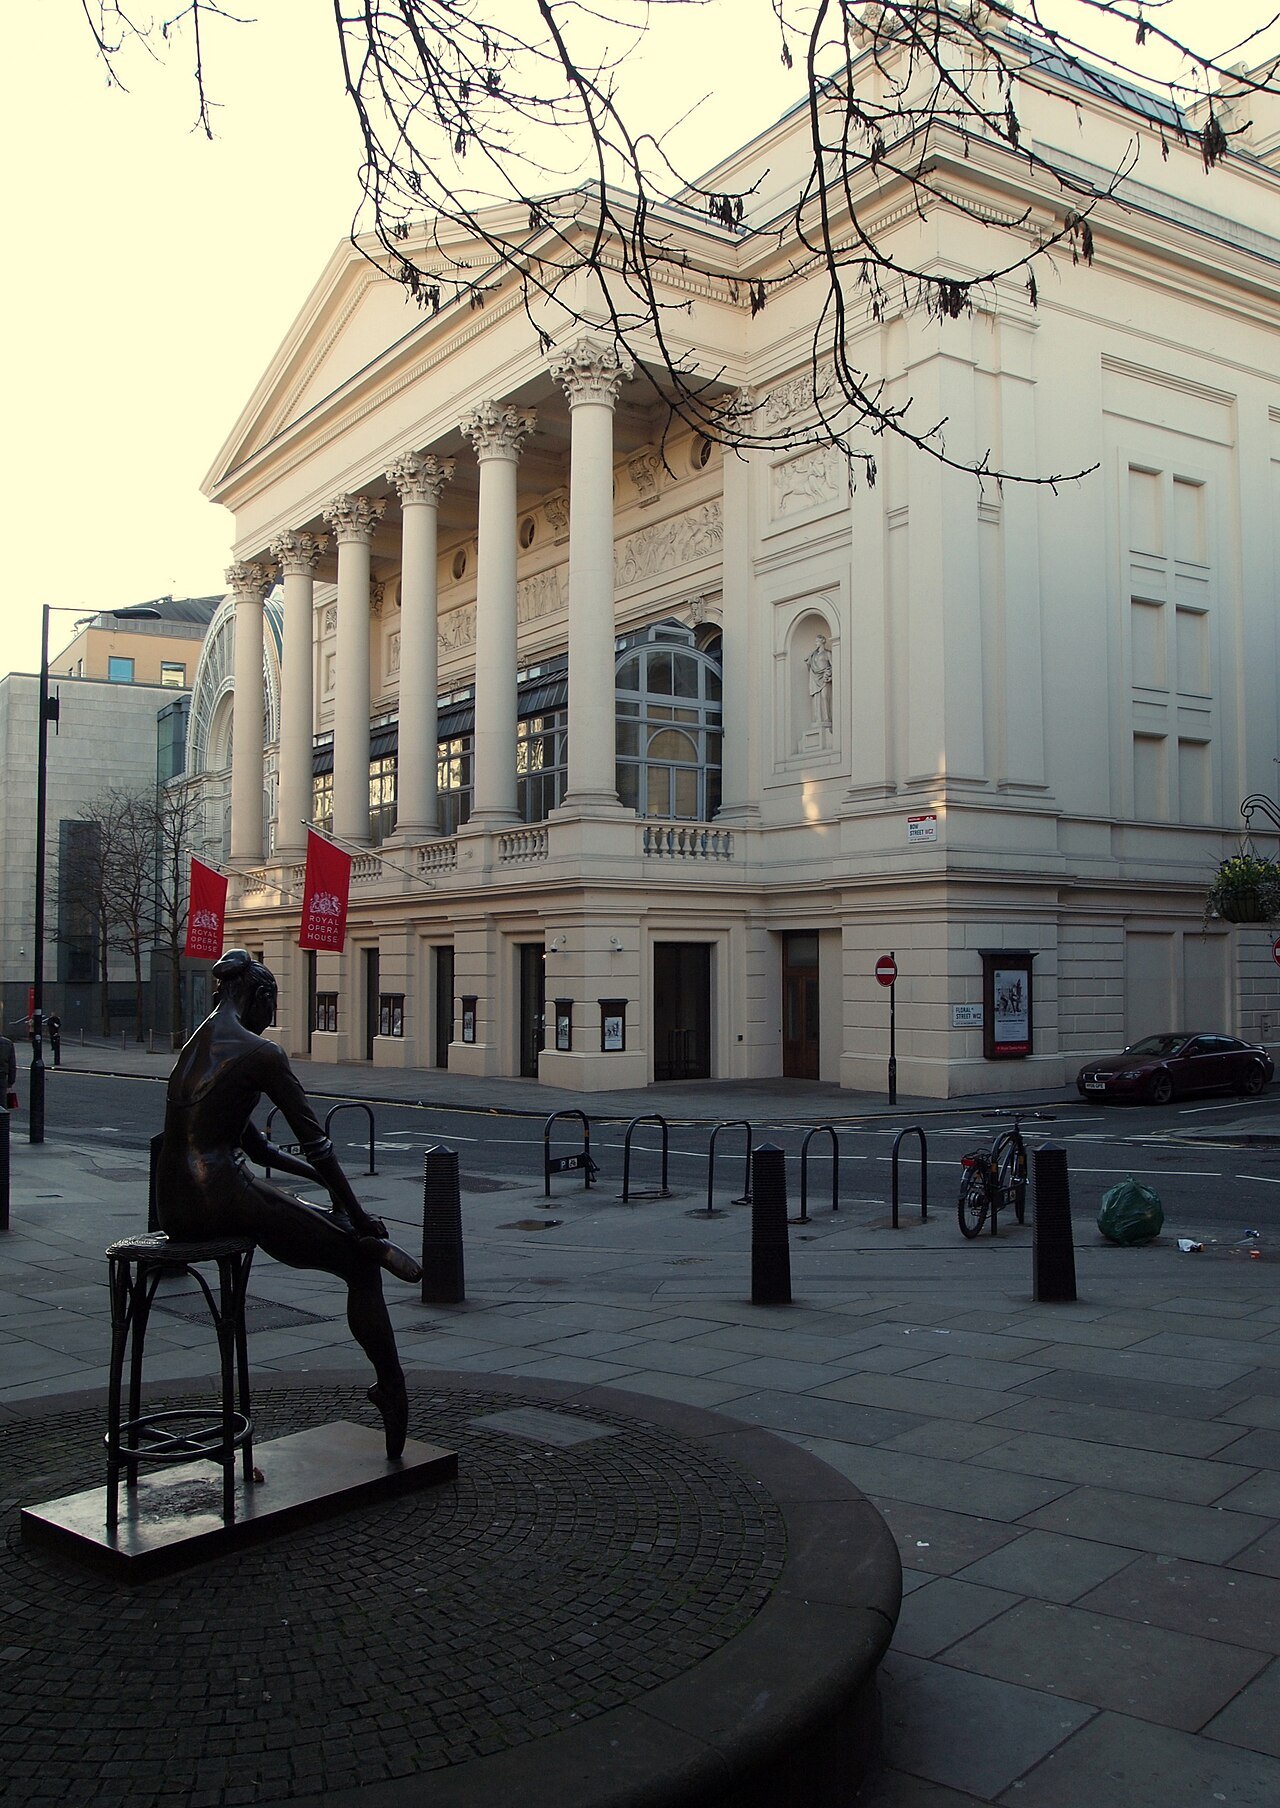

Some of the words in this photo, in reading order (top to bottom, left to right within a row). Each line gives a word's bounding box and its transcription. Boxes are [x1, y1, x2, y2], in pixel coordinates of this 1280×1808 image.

[309, 915, 339, 926] ROYAL
[191, 928, 217, 938] ROYAL
[307, 923, 338, 934] OPERA
[190, 936, 218, 945] OPERA
[307, 932, 338, 943] HOUSE
[190, 943, 218, 953] HOUSE
